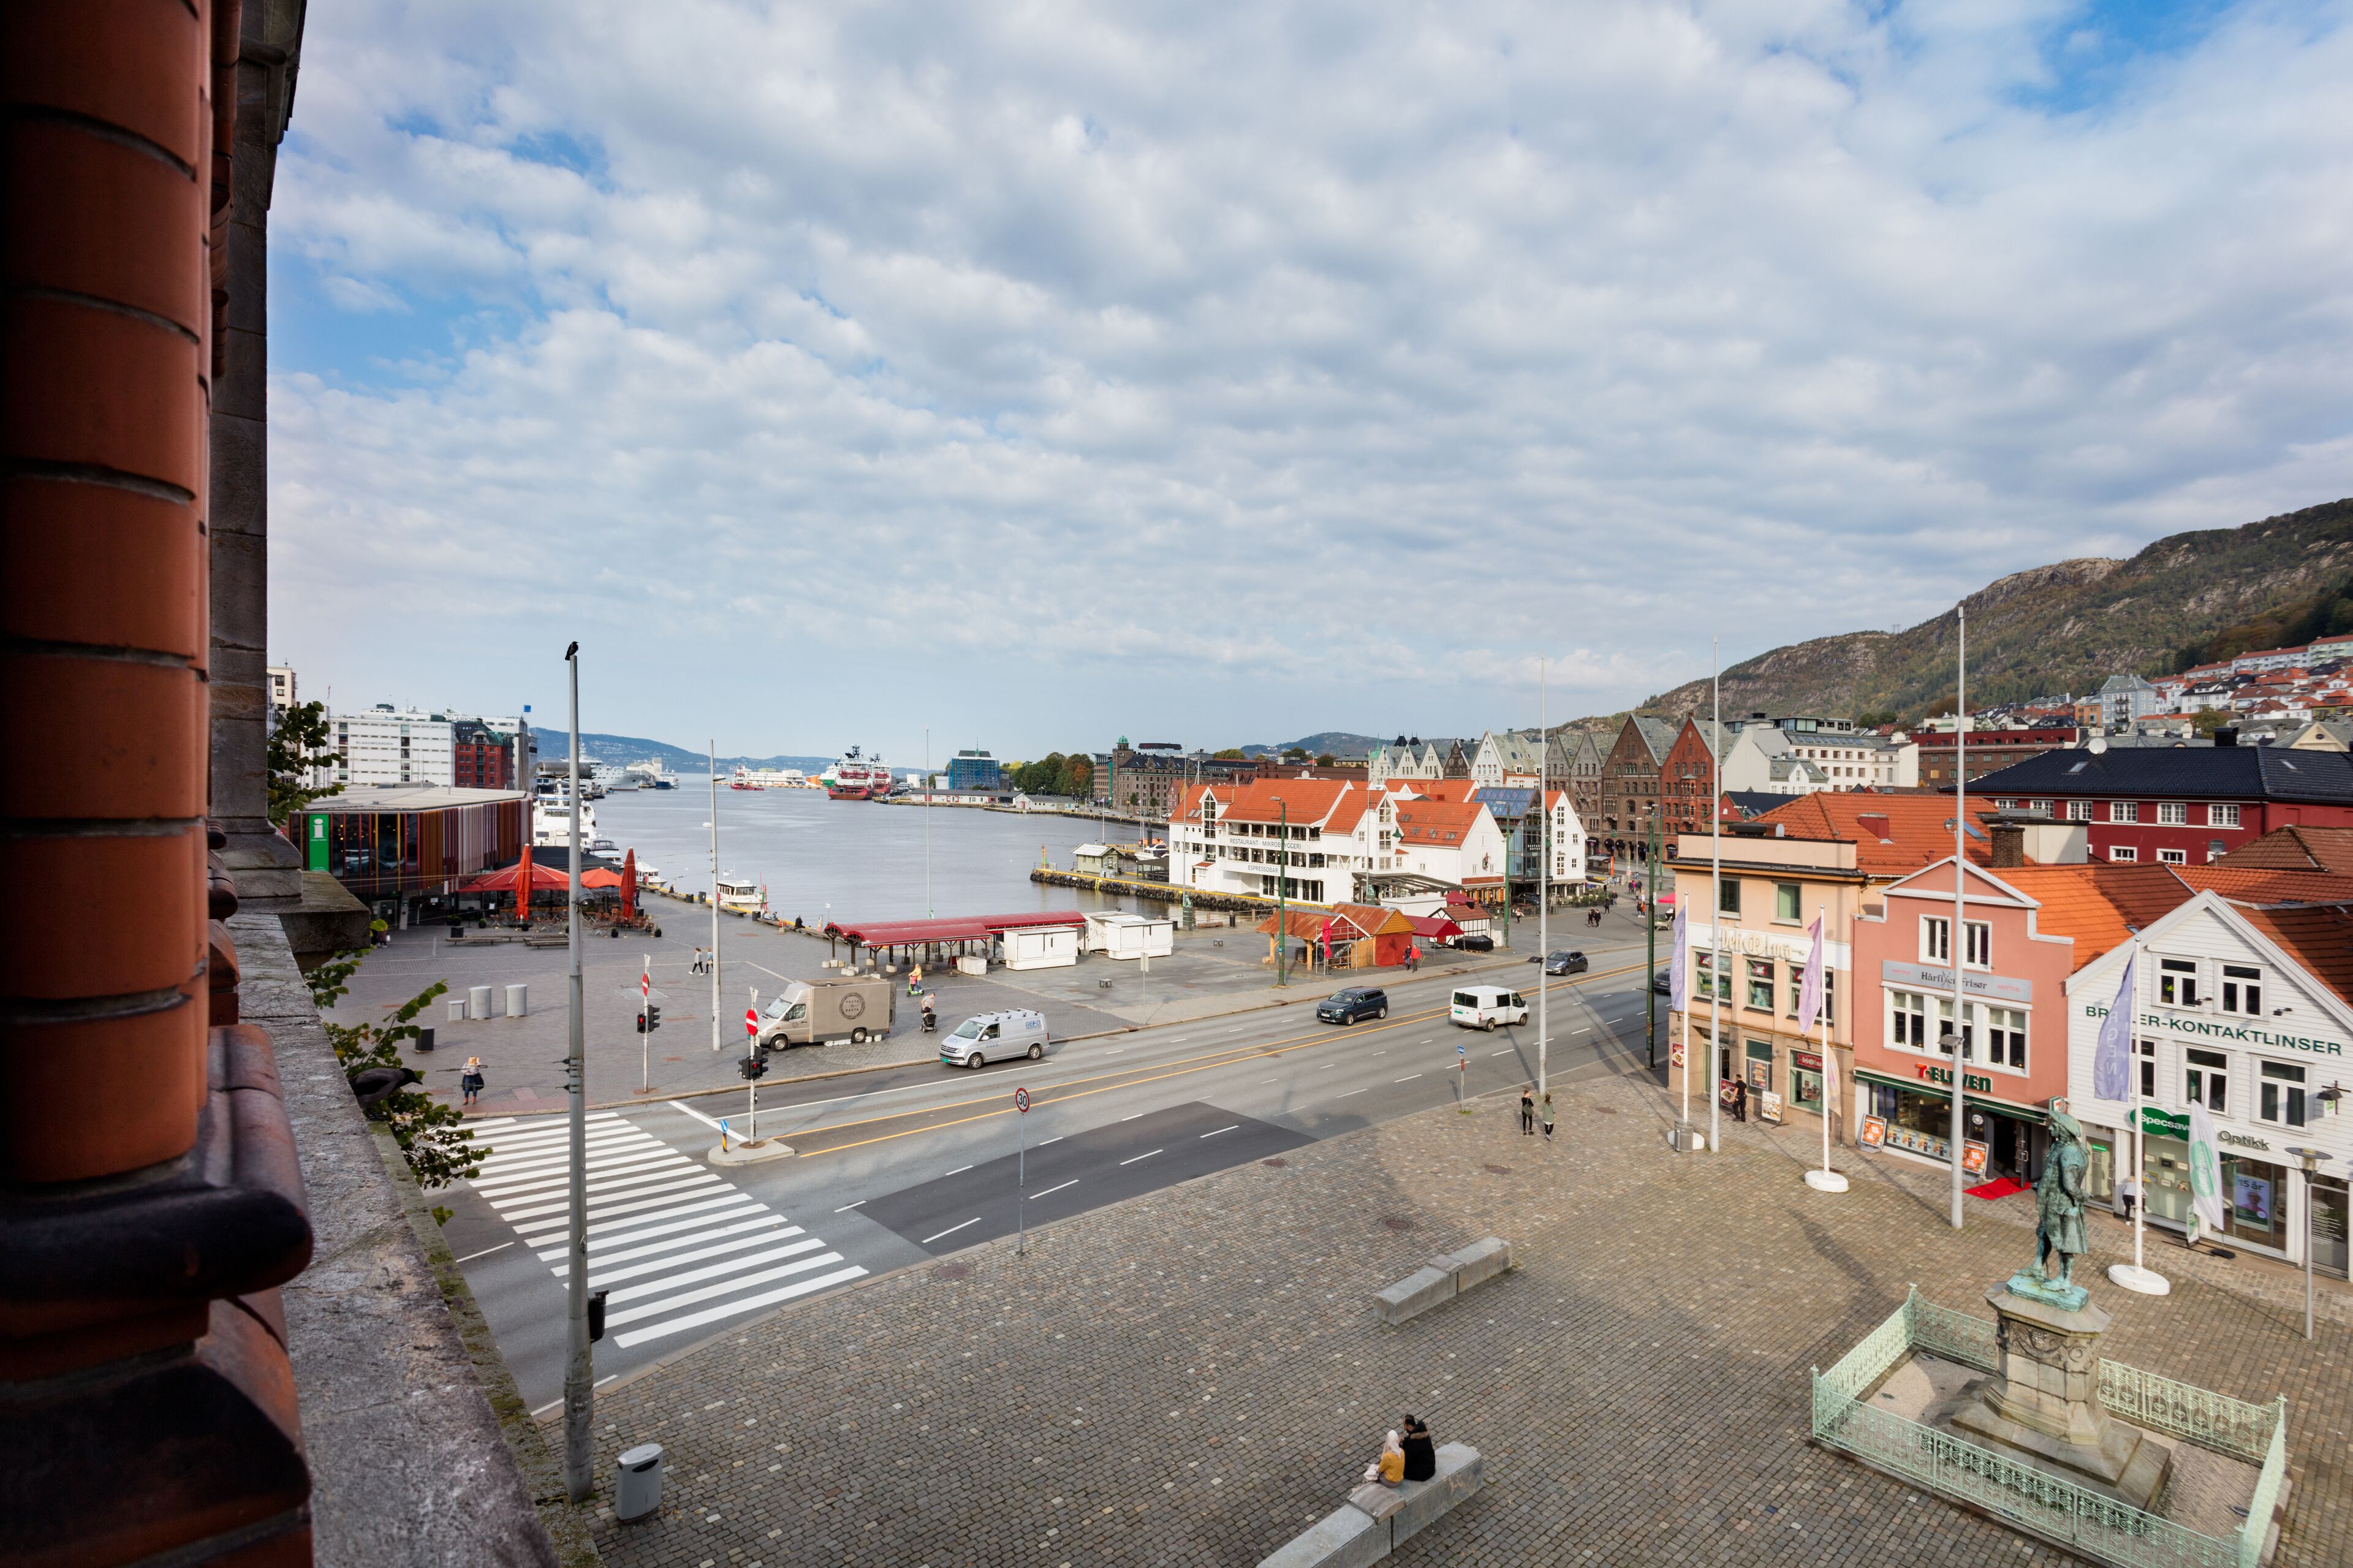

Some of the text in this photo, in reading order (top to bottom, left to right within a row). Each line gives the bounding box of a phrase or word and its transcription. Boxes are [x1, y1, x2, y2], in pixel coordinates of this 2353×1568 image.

[1262, 841, 1302, 850] MIKROBYGGERI
[1248, 865, 1279, 873] ESPRESSOBAR
[2086, 1006, 2343, 1056] BRER-KONTAKTLINSER
[1018, 1093, 1028, 1107] 30
[2219, 1130, 2270, 1151] Optikk
[2237, 1178, 2265, 1192] 15 år
